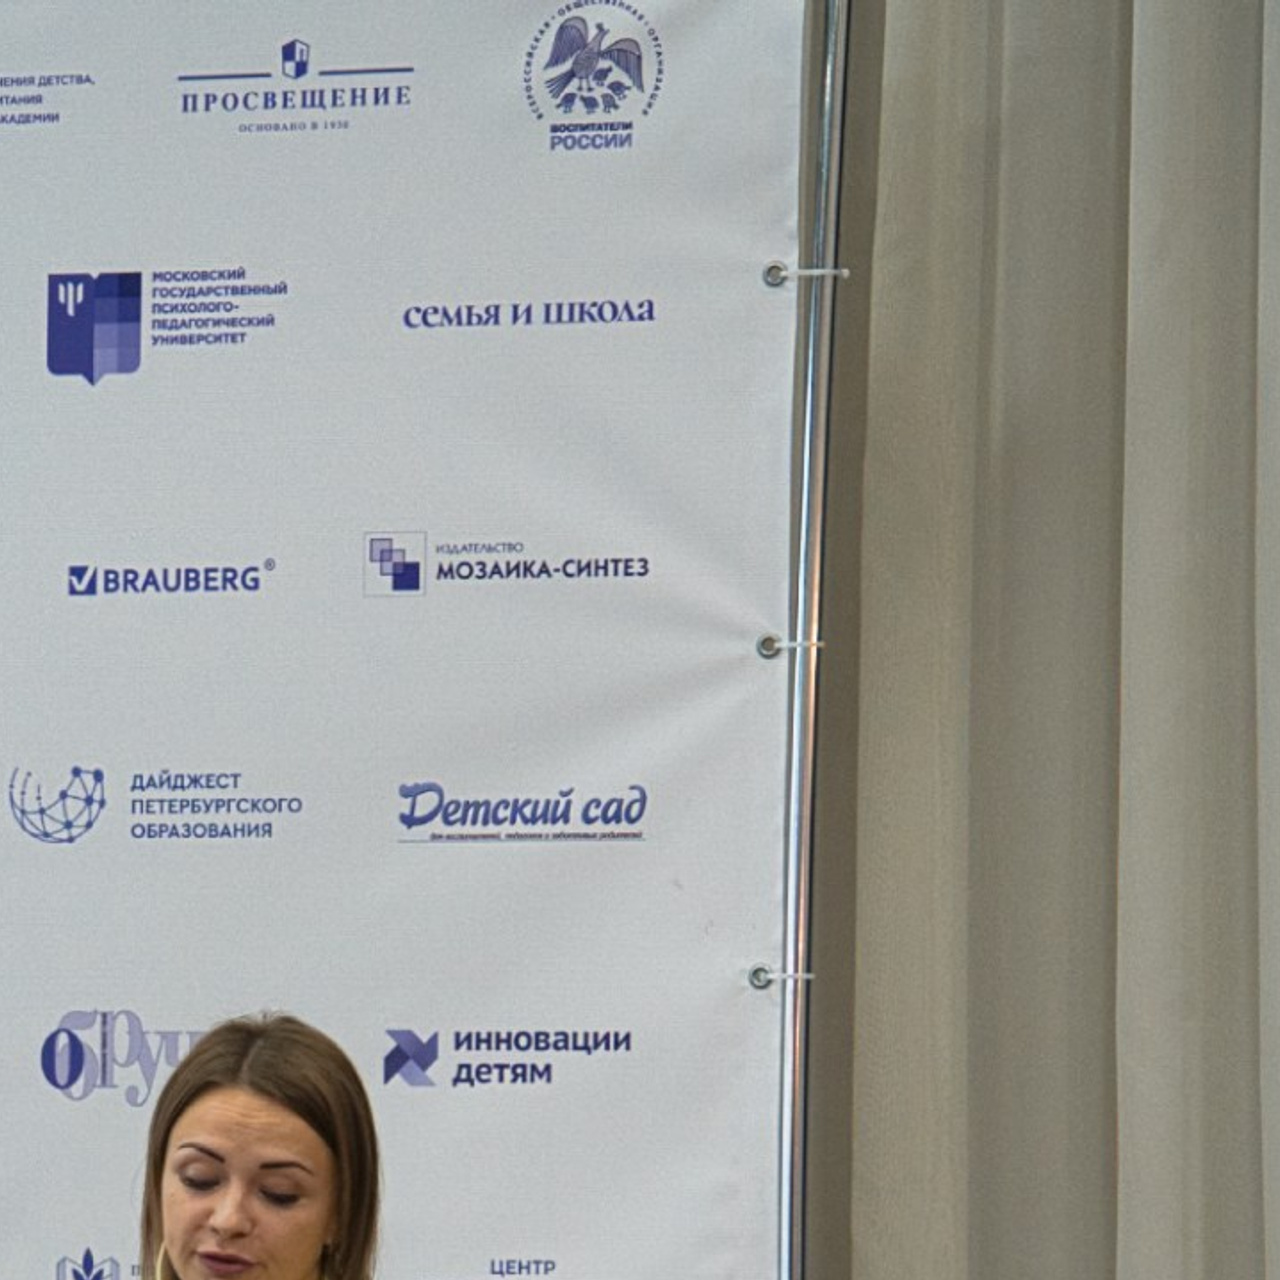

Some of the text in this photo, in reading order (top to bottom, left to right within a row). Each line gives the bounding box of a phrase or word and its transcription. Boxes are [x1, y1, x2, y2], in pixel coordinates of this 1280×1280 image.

[37, 74, 96, 88] ДЕТСТВА,
[182, 85, 411, 113] ПРОСВЕЩЕНИЕ
[238, 121, 307, 133] ОСНОВАНО
[310, 121, 319, 131] В
[549, 121, 634, 136] ВОСПИТАТЕЛИ
[549, 131, 633, 151] РОССИИ
[151, 266, 246, 283] МОСКОВСКИЙ
[151, 279, 288, 299] ГОСУДАРСТВЕННЫЙ
[151, 300, 240, 315] ПСИХОЛОГО-
[402, 299, 655, 329] семья и школа
[151, 312, 276, 332] ПЕДАГОГИЧЕСКИЙ
[151, 331, 247, 347] УНИВЕРСИТЕТ
[436, 542, 524, 554] ИЗДАТЕЛЬСТВО
[436, 557, 650, 581] МОЗАИКА-СИНТЕЗ
[130, 769, 242, 792] ДАЙДЖЕСТ
[131, 797, 303, 815] ПЕТЕРБУРГСКОГО
[398, 782, 648, 830] Детский сад
[130, 822, 273, 839] ОБРАЗОВАНИЯ
[454, 1030, 632, 1056] инновации
[451, 1062, 552, 1088] детям
[490, 1259, 556, 1278] ЦЕНТР
